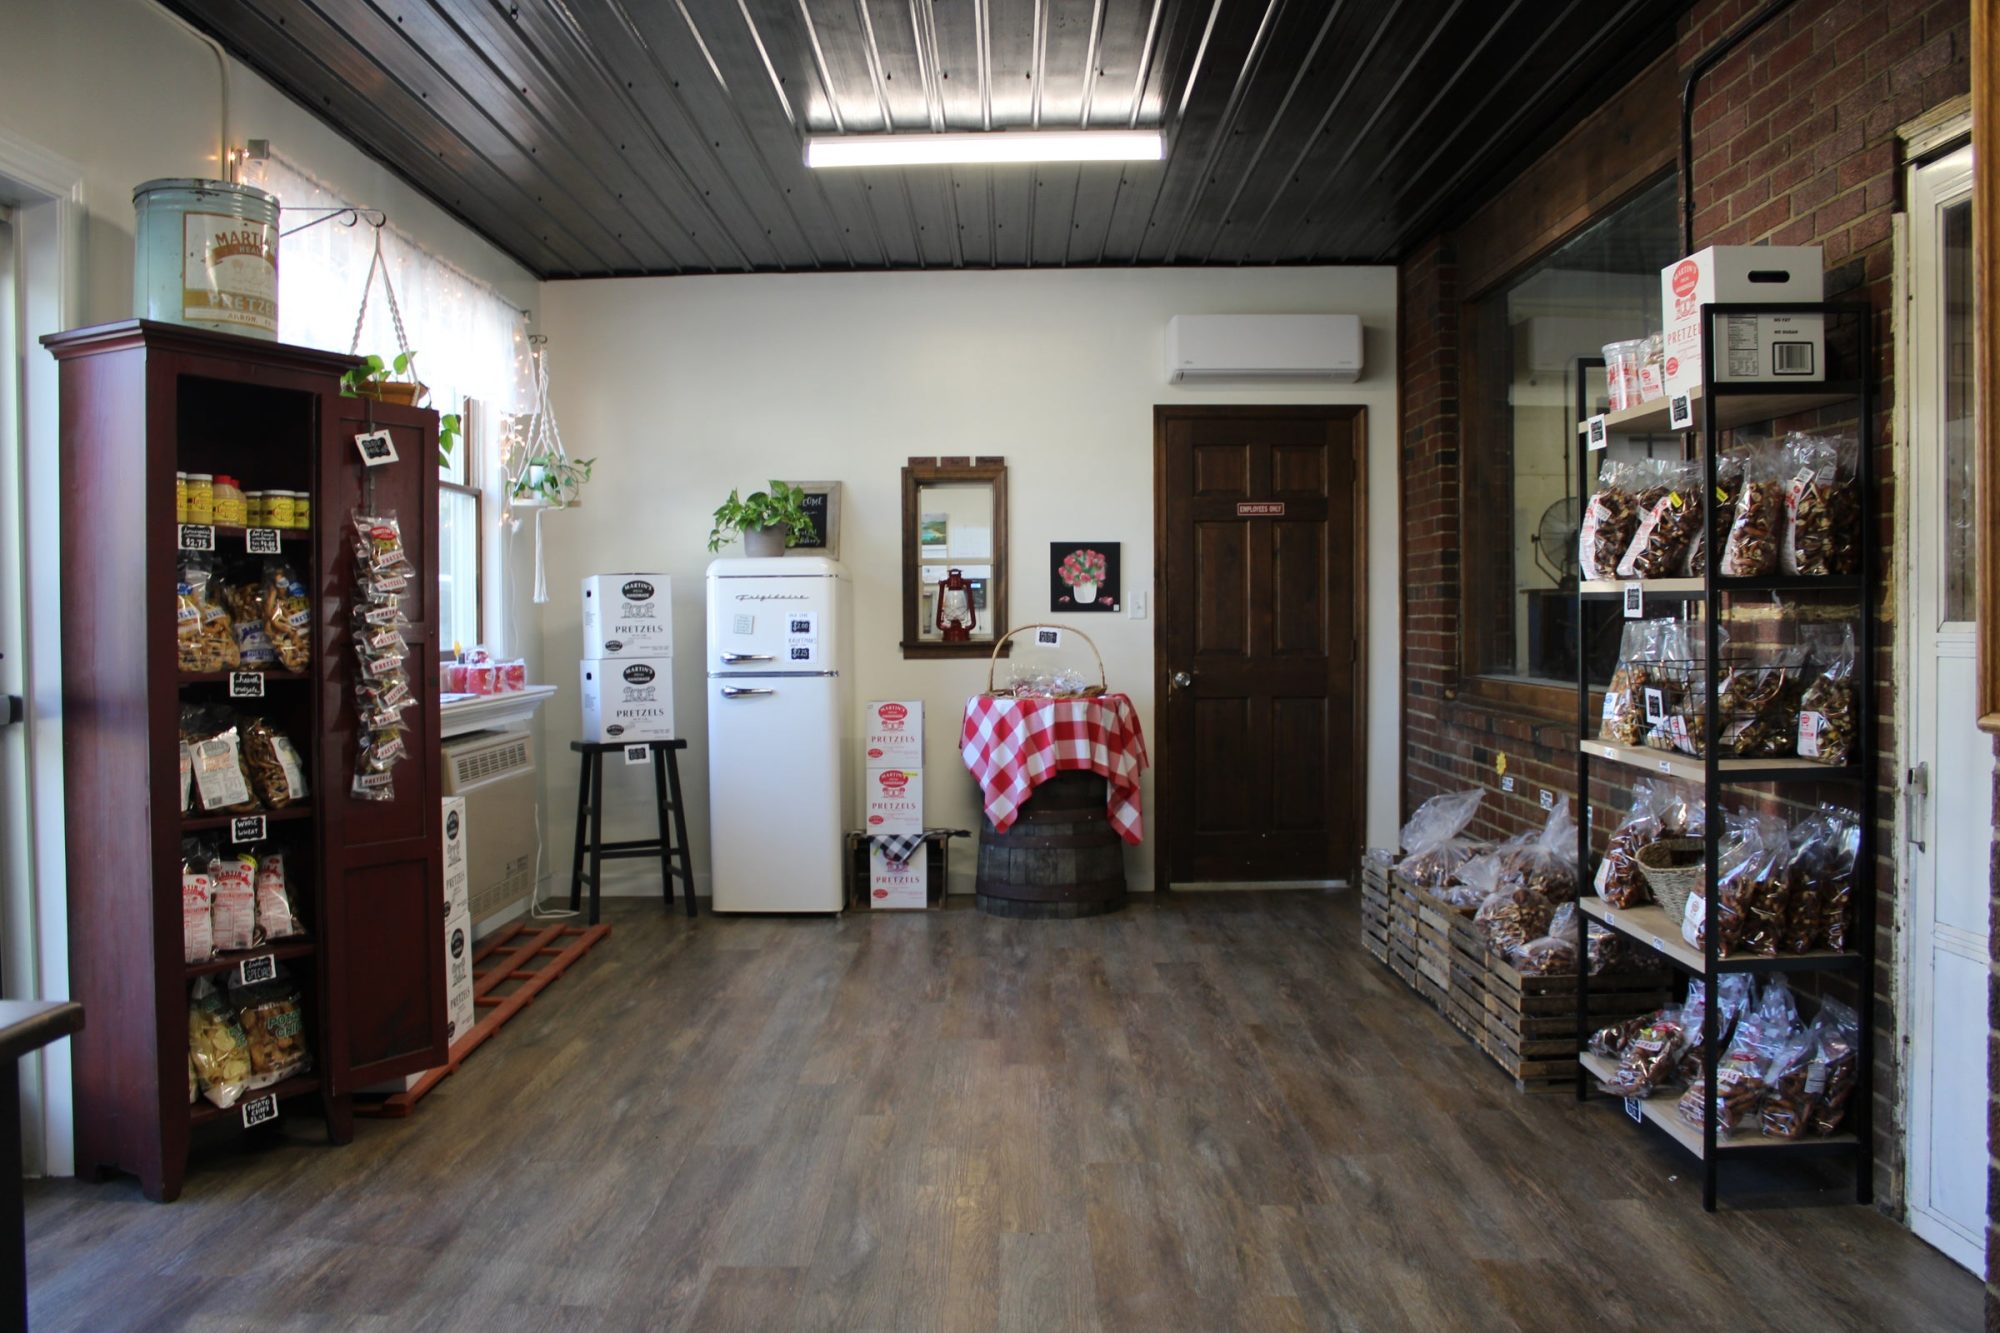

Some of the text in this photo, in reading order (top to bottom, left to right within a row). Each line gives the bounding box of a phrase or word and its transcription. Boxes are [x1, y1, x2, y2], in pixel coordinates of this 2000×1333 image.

[1239, 505, 1268, 513] EMPLOYEES
[615, 625, 663, 633] PRETZELS
[626, 666, 653, 674] MARTIN'S
[616, 708, 664, 717] PRETZELS
[871, 735, 915, 743] PRETZELS
[237, 828, 259, 836] WHEAT
